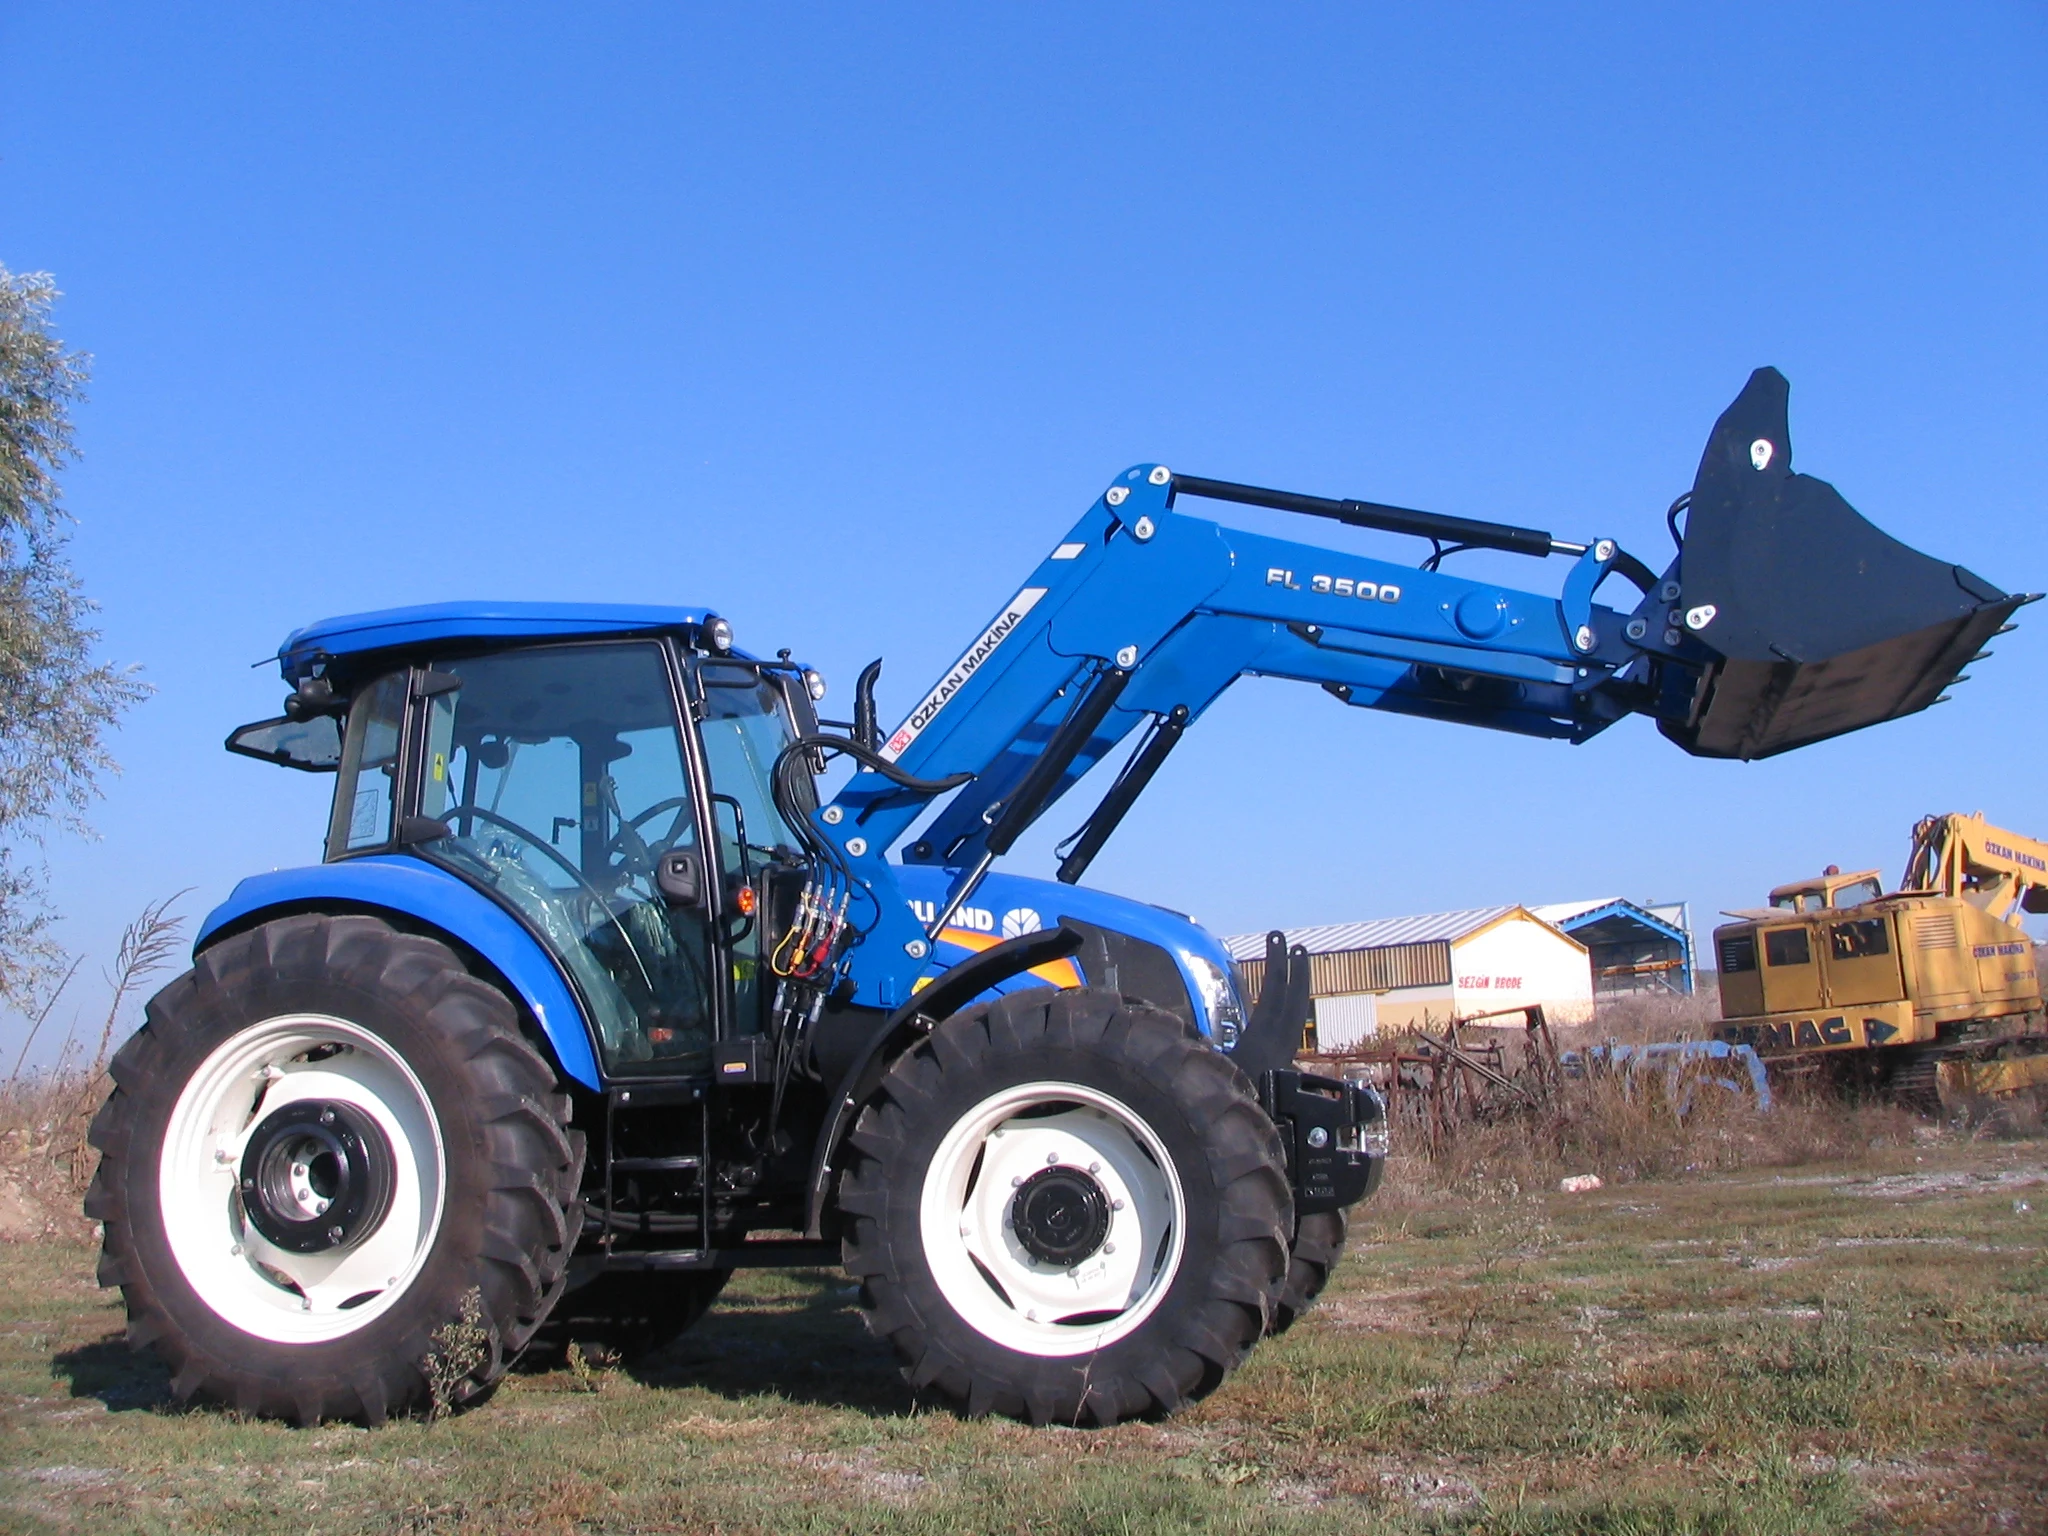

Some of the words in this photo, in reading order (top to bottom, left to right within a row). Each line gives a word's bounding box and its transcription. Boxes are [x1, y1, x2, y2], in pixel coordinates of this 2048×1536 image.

[1266, 568, 1301, 590] FL
[1310, 575, 1402, 604] 3500
[910, 672, 964, 730] ÖZKAN
[962, 611, 1021, 674] MAKİNA
